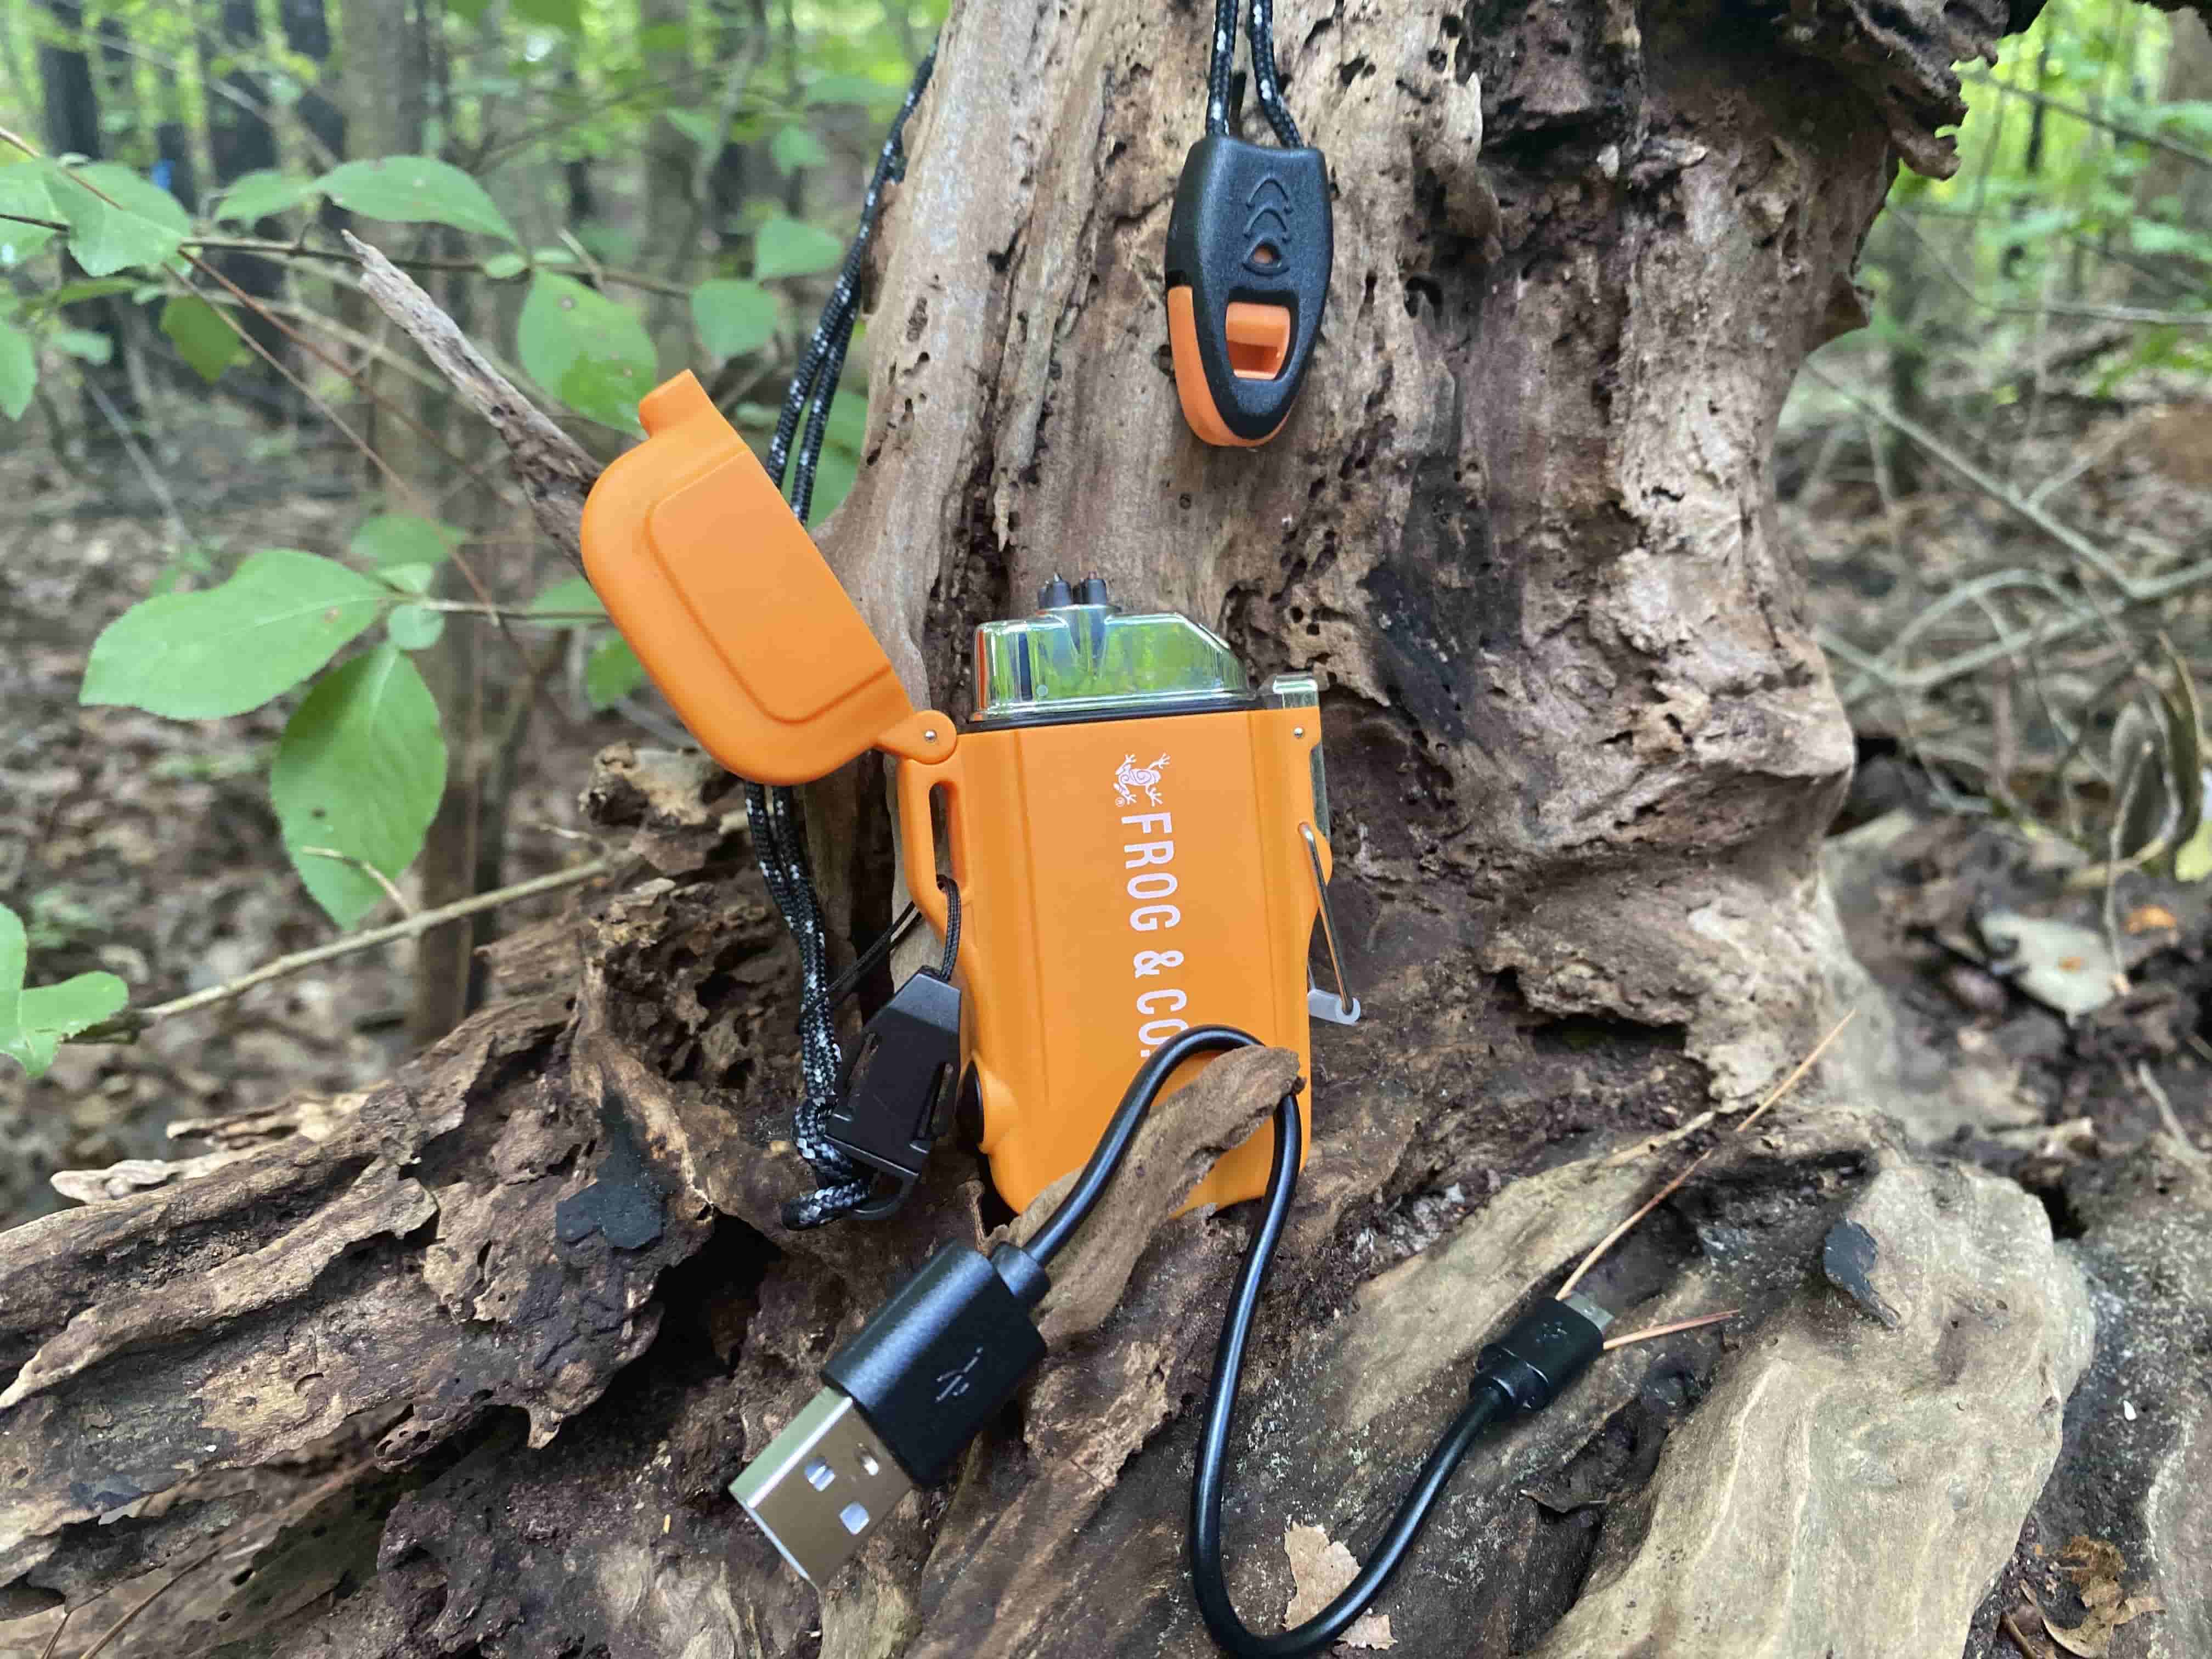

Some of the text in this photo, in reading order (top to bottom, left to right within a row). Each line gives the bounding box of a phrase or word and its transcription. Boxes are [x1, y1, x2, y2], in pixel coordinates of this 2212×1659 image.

[1121, 812, 1189, 1058] FROG & CO.
